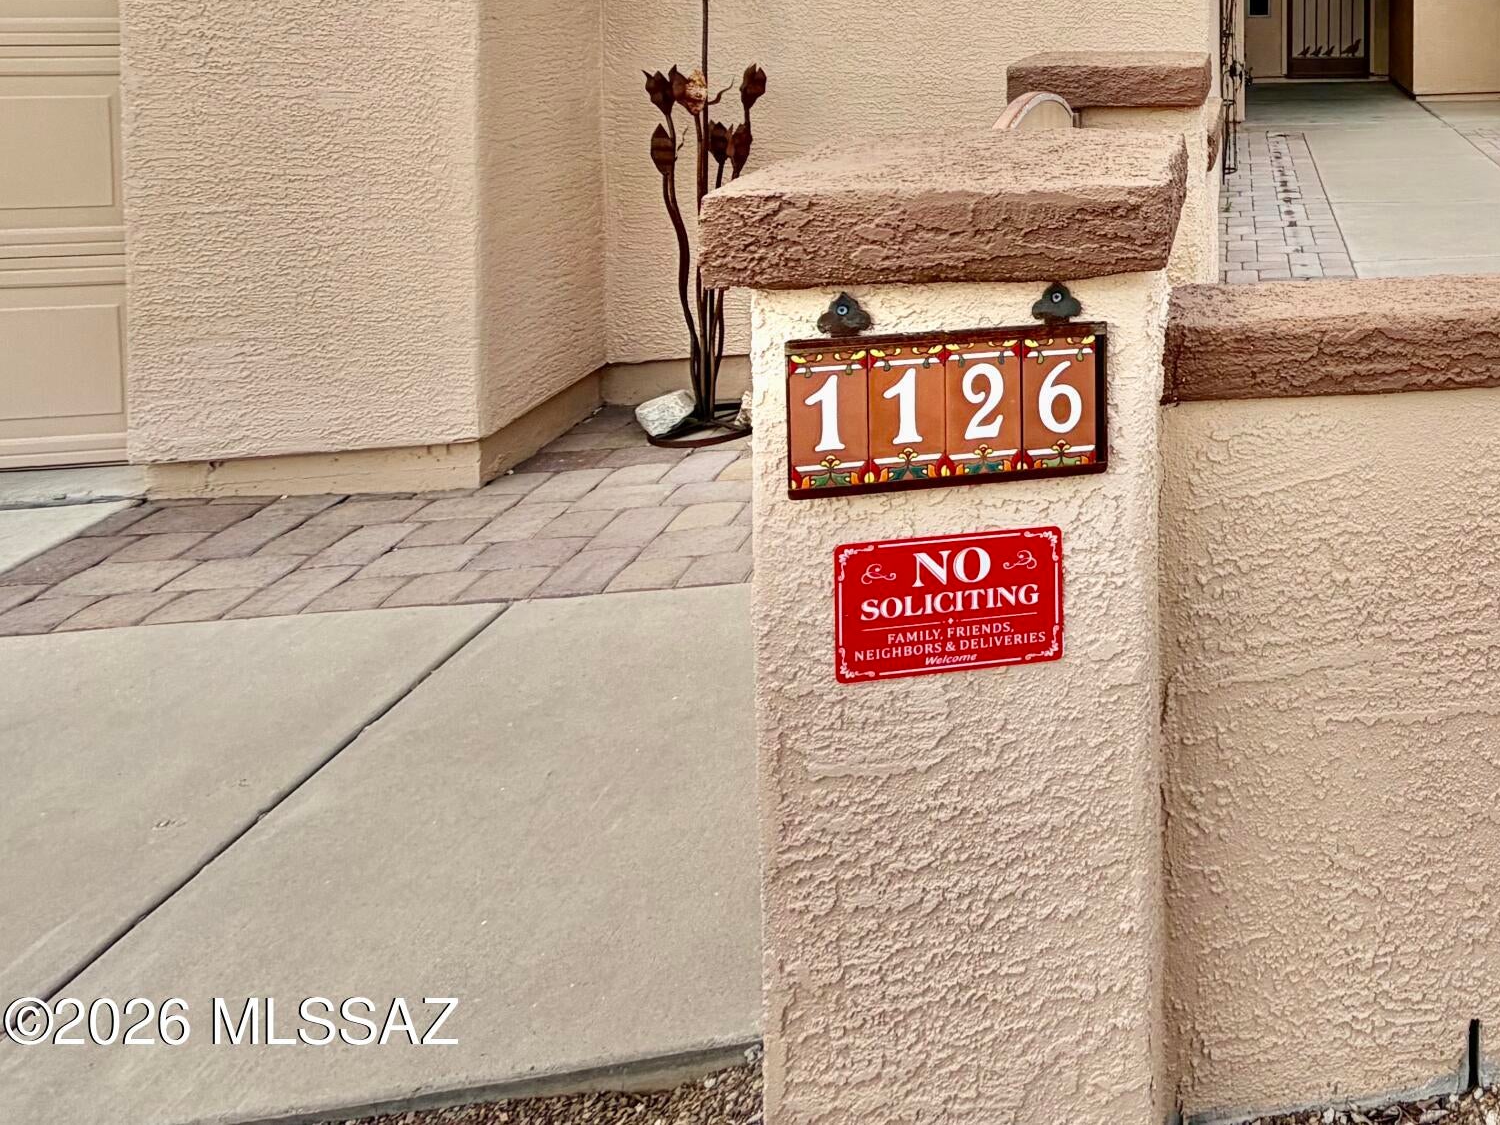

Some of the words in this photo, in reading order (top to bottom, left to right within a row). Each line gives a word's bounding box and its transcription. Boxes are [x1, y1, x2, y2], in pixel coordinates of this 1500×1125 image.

[803, 360, 1082, 452] 1126
[911, 546, 992, 588] NO
[860, 583, 1040, 621] SOLICITING
[854, 641, 942, 662] NEIGHBORS
[945, 640, 956, 652] &
[959, 631, 1046, 651] DELIVERIES
[924, 652, 978, 666] Welcome
